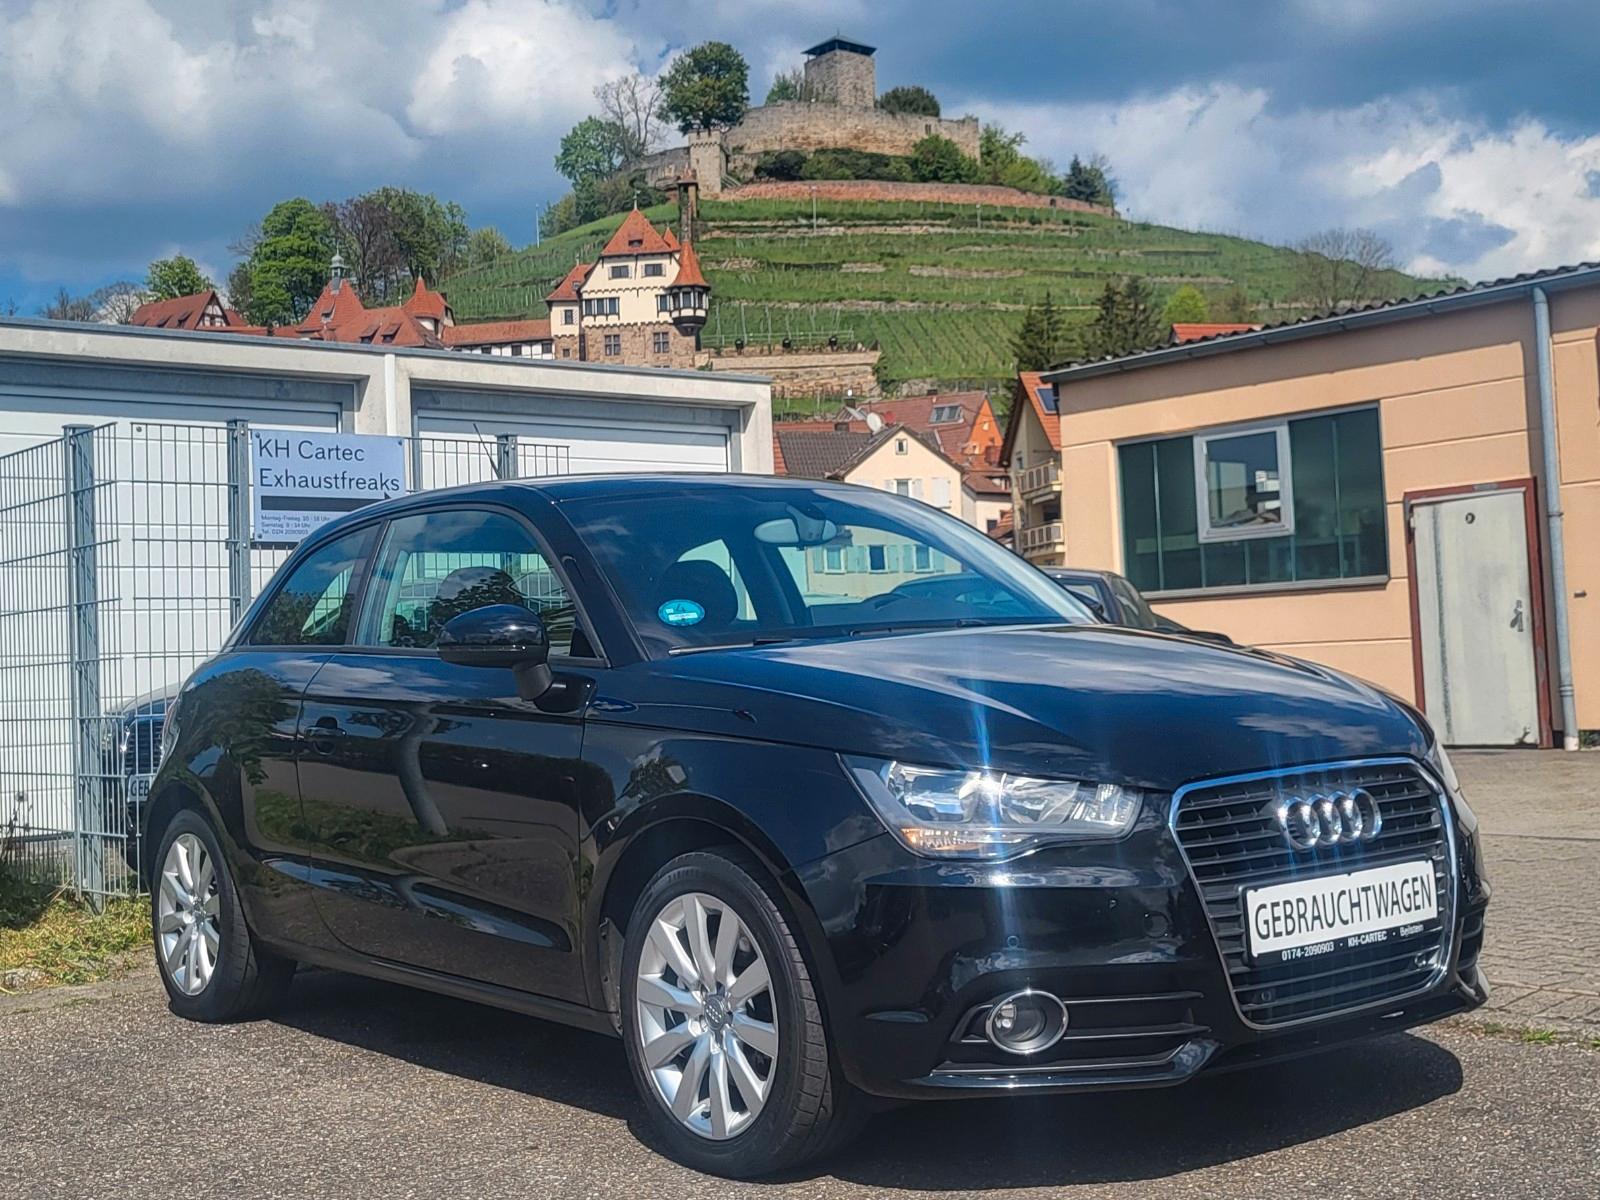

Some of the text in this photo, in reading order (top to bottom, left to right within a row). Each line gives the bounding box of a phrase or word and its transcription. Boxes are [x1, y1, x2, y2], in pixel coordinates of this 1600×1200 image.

[259, 438, 365, 462] KH Cartec
[260, 468, 400, 491] Exhaustfreaks
[1254, 873, 1432, 940] GEBRAUCHTWAGEN
[1281, 941, 1335, 961] 0174-2090903
[1347, 930, 1388, 948] KH-CARTEC
